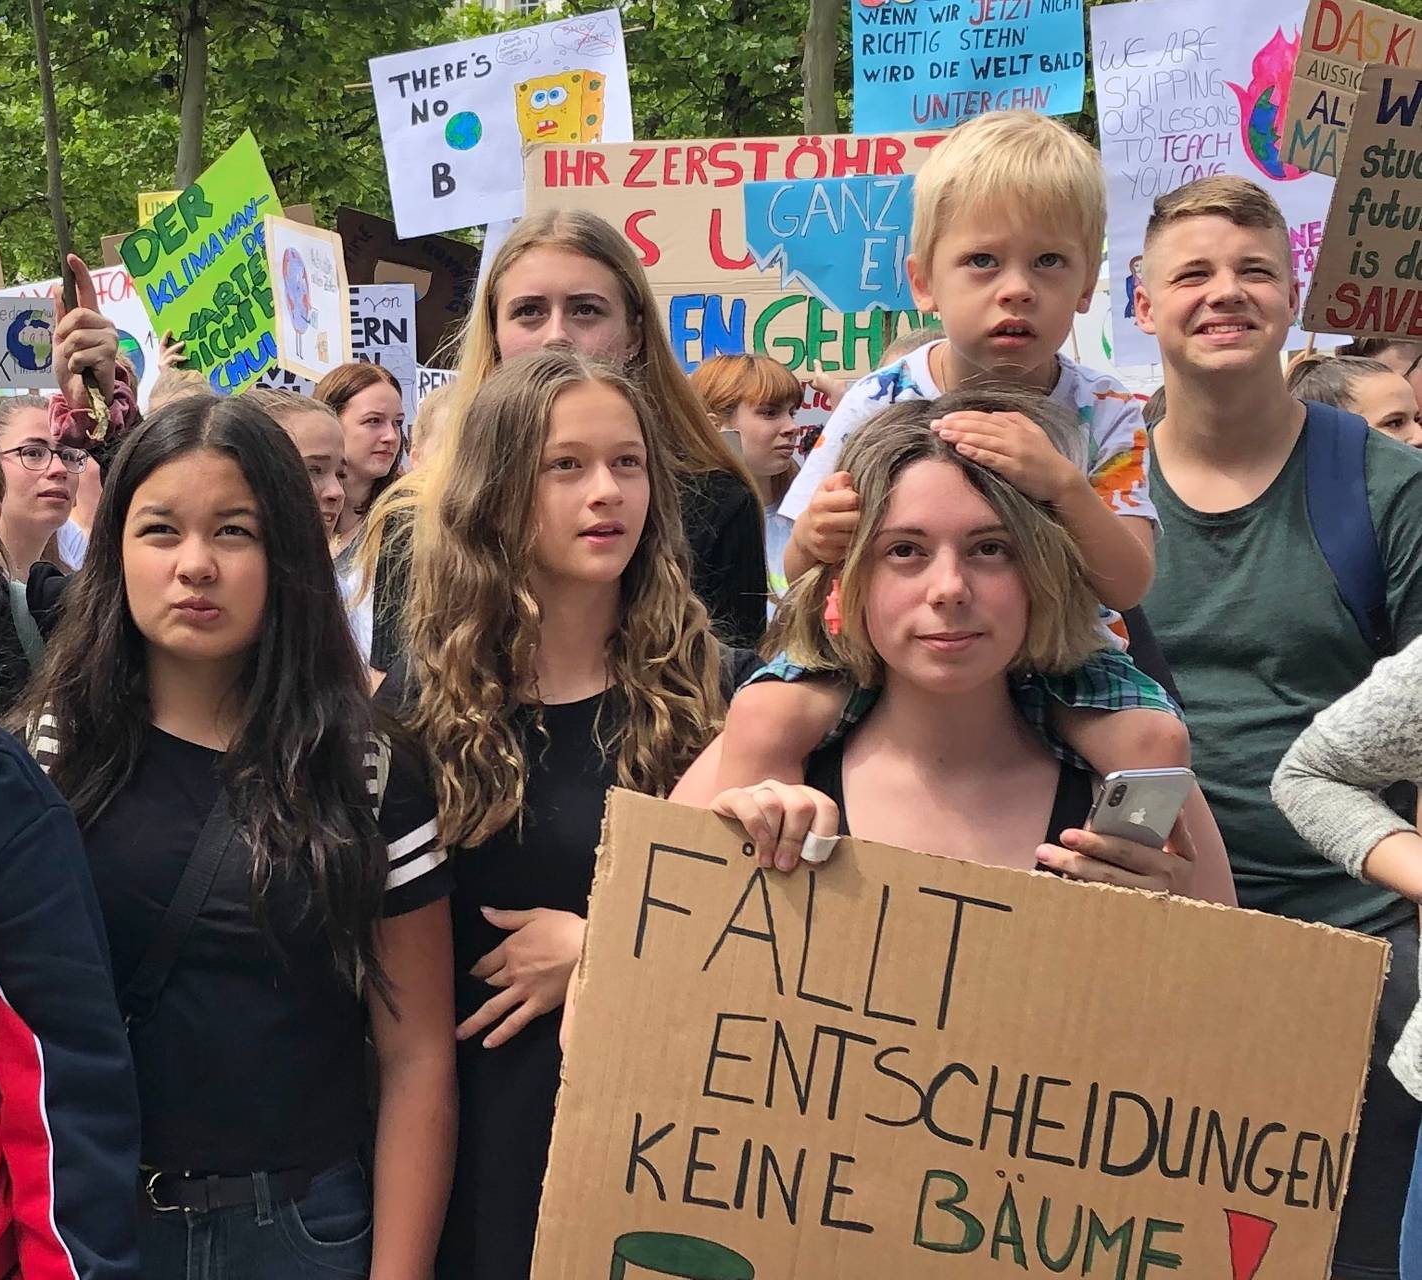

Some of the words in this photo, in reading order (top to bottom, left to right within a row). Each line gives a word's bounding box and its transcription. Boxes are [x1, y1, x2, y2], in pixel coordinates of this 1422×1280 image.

[858, 8, 917, 26] WENN
[929, 4, 960, 24] WIR
[862, 30, 940, 56] RICHTIG
[1100, 37, 1148, 71] WE
[1155, 26, 1218, 66] ARE
[863, 65, 915, 83] WIRD
[930, 61, 960, 79] DIE
[970, 54, 1034, 80] WELT
[1040, 51, 1084, 73] BALD
[1104, 68, 1227, 109] SKIPPING
[411, 99, 449, 126] NO
[1102, 103, 1156, 139] OUR
[1160, 104, 1240, 133] LESSONS
[1306, 90, 1354, 127] AL
[544, 149, 610, 187] IHR
[622, 135, 951, 188] ZERSTÖHR
[1112, 137, 1154, 163] TO
[1159, 132, 1232, 163] TEACH
[431, 161, 456, 199] B
[1122, 167, 1175, 200] YOU
[1348, 187, 1422, 236] futu
[120, 184, 214, 278] DER
[1349, 241, 1379, 279] is
[701, 1013, 1350, 1211] ENTSCHEIDUNGEN
[624, 1112, 875, 1234] KEINE
[913, 1168, 1185, 1280] BÄUME
